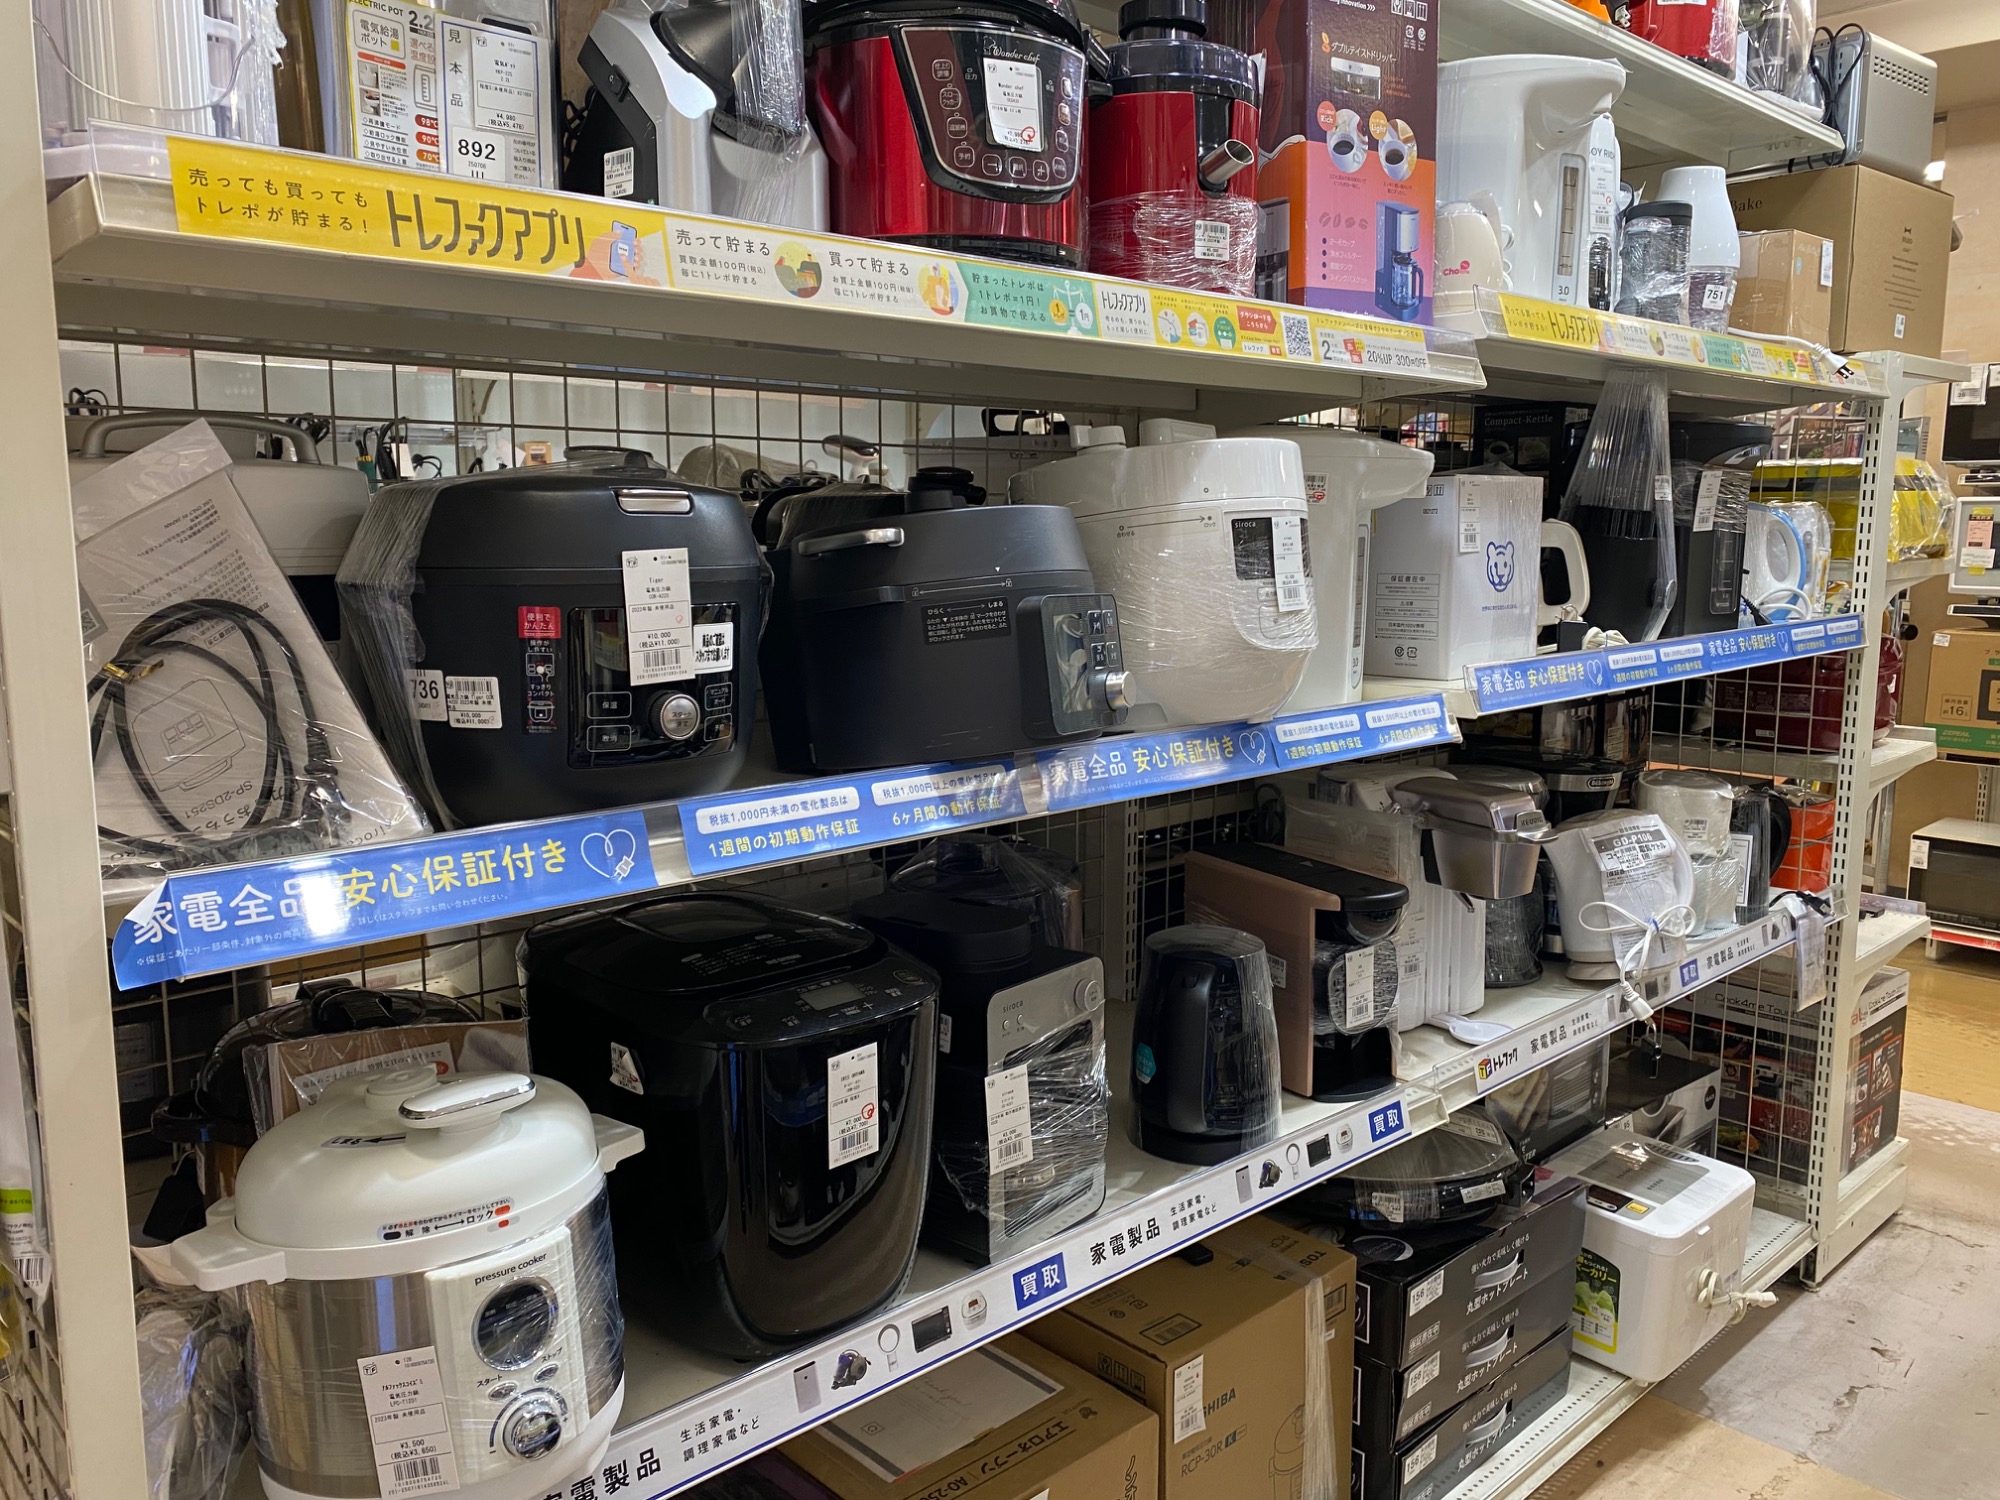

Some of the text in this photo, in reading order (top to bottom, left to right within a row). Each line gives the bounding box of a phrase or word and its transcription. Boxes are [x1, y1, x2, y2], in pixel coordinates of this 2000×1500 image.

[388, 6, 403, 16] POT
[360, 19, 399, 39] 電気給湯
[361, 34, 387, 46] ポット
[993, 46, 1040, 63] Wonder chef
[1320, 115, 1334, 124] Rich
[1371, 123, 1387, 133] Light
[458, 139, 496, 160] 892
[188, 168, 369, 209] 売っても買っても
[386, 189, 586, 269] トレファクアプリ
[676, 229, 770, 256] 売って貯まる
[829, 251, 909, 276] 買って貯まる
[972, 273, 1044, 292] 貯まったトレポは
[1558, 285, 1570, 295] 3.0
[1101, 290, 1146, 313] トレファクアプリ
[1706, 289, 1724, 301] 751
[980, 305, 1046, 322] お買物で使える
[1321, 340, 1332, 361] 2
[1366, 350, 1392, 365] 20%UP
[1484, 414, 1553, 426] Compact-Kettle
[1391, 575, 1426, 583] 保証書在中
[527, 613, 550, 621] 便利で
[927, 601, 1004, 615] ひらく しまる
[524, 622, 554, 630] かんたん
[639, 639, 680, 648] (税込¥11,000)
[1481, 663, 1585, 696] 家電全品 安心保証付き
[1285, 736, 1363, 760] 1週間の初期動作保証
[1047, 751, 1127, 787] 家電全品
[1133, 734, 1235, 773] 安心保証付き
[185, 779, 254, 820] SP-2DS251
[709, 795, 848, 827] 税抜1,000円未満の電化製品は
[708, 818, 861, 858] 1週間の初期動作保証
[1613, 833, 1652, 846] GD-P106
[341, 838, 567, 907] 安心保証付き
[1002, 1000, 1024, 1013] siroca
[1714, 992, 1799, 1019] Cook4me Touch
[1530, 1025, 1568, 1054] 家電製品
[1492, 1046, 1519, 1074] トレファク
[846, 1116, 862, 1127] ¥7,000
[1372, 1108, 1400, 1136] 買取
[466, 1210, 493, 1224] ロック
[1172, 1201, 1218, 1232] 調理家電など
[1089, 1216, 1161, 1267] 家電製品
[474, 1253, 548, 1286] pressure cooker
[1020, 1265, 1061, 1300] 買取
[1466, 1268, 1528, 1315] 丸型ホットプレート
[1412, 1288, 1425, 1304] 156
[542, 1347, 563, 1363] ストップ
[1456, 1343, 1518, 1393] 丸型ホットプレート
[477, 1374, 503, 1388] スタート
[1410, 1372, 1422, 1385] 156
[400, 1439, 425, 1449] ¥3,500
[682, 1416, 760, 1463] 調理家電など
[979, 1420, 1070, 1477] エアロオーブン
[1458, 1416, 1517, 1472] 丸型ホットプレート
[390, 1446, 437, 1460] (税込¥3,850)
[1181, 1440, 1223, 1477] RCP-30R
[1407, 1457, 1419, 1470] 156
